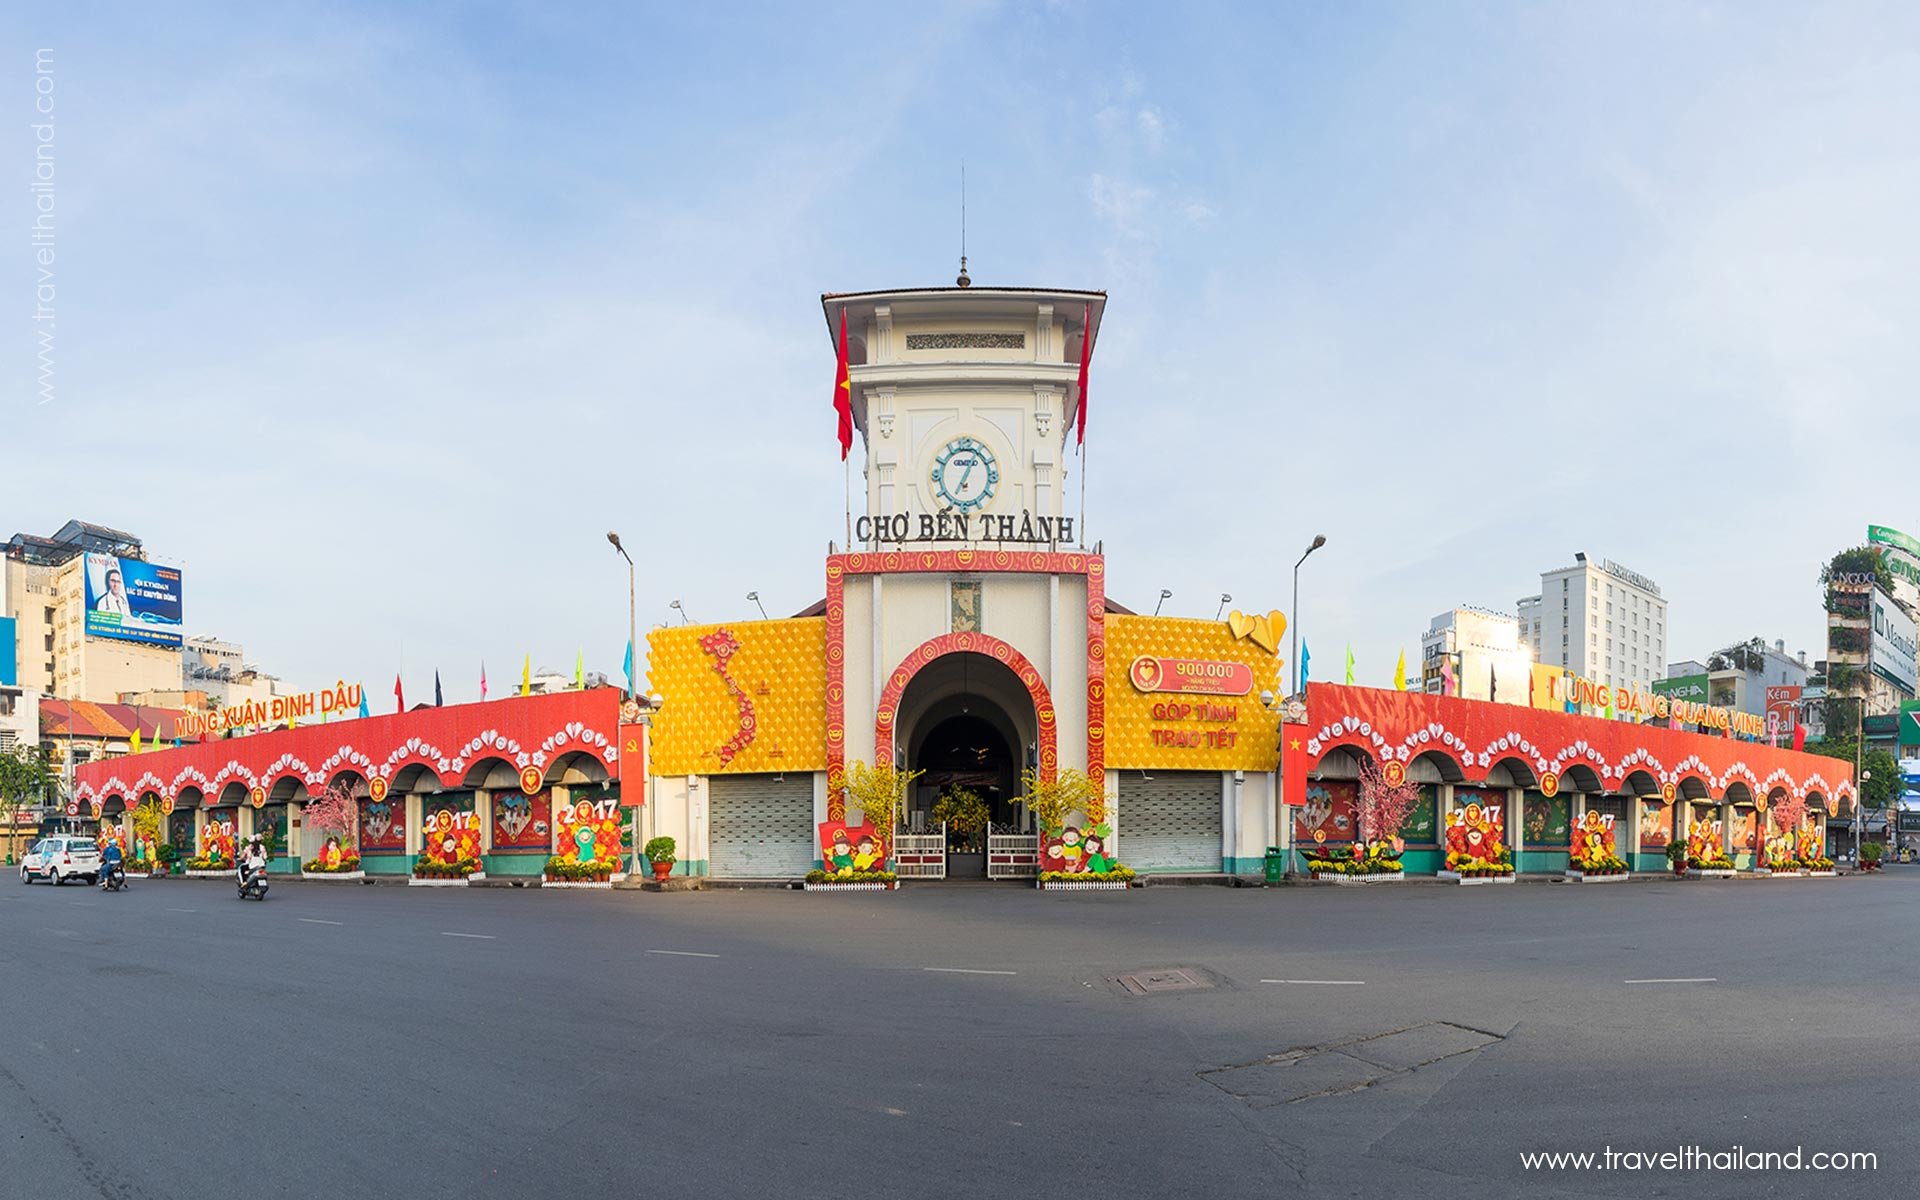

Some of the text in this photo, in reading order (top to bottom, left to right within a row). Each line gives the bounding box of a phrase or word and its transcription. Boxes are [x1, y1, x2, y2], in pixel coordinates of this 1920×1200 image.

[856, 506, 1074, 544] CHỢ BẾN THÀNH
[1176, 662, 1234, 679] 900.000
[175, 680, 362, 738] MỪNG XUÂN ĐINH DẬU
[1153, 699, 1237, 721] GÓP TÌNH
[1550, 671, 1764, 737] MỪNG ĐẢNG QUANG VINH
[1152, 727, 1238, 748] TRAO TẾT
